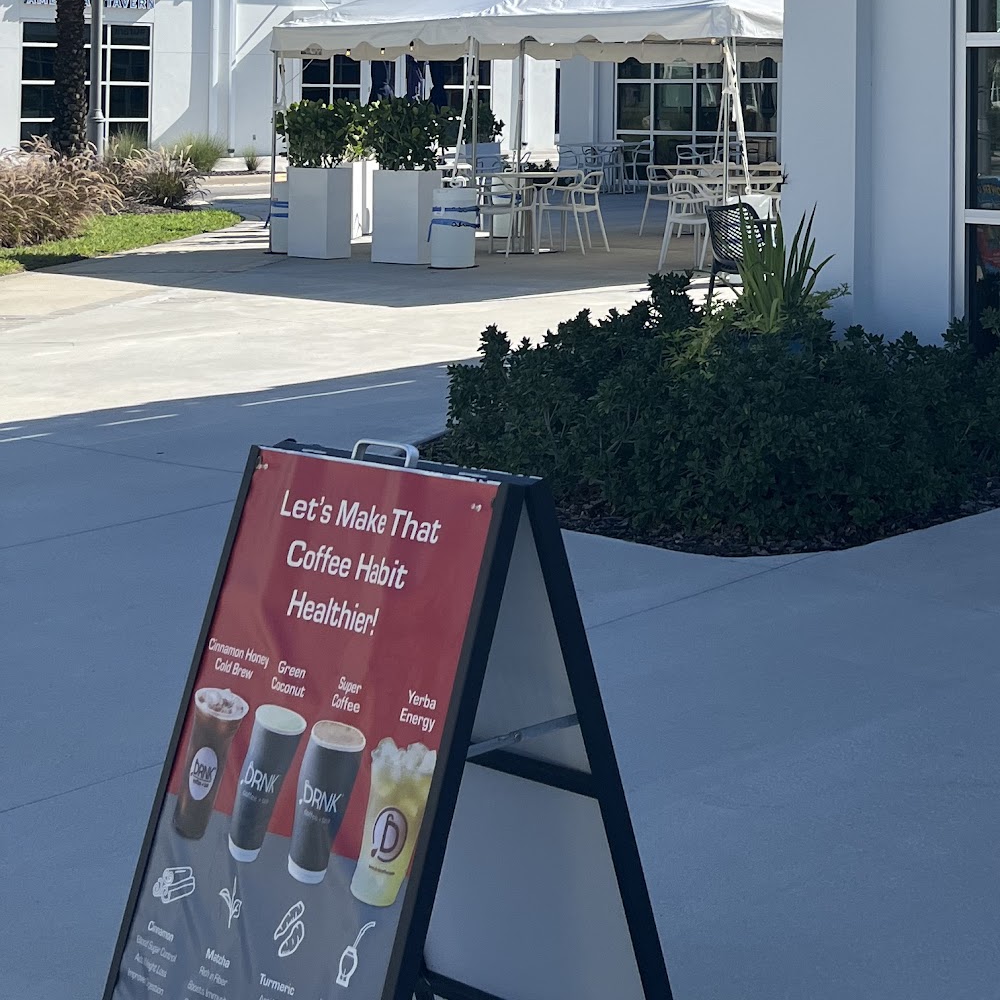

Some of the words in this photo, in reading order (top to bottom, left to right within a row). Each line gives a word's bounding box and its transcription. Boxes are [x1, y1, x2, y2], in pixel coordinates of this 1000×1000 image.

[280, 489, 333, 525] Let's
[335, 500, 387, 535] Make
[390, 508, 442, 544] That
[286, 540, 352, 578] Coffee
[355, 552, 408, 590] Habit
[287, 589, 380, 637] Healthier!
[208, 637, 245, 660] Cinnamon
[246, 648, 270, 669] Honey
[214, 657, 231, 674] Cold
[232, 664, 254, 680] Brew
[277, 660, 306, 680] Green
[271, 677, 306, 698] Coconut
[338, 676, 362, 696] Super
[331, 693, 360, 714] Coffee
[408, 690, 437, 711] Yerba
[399, 708, 436, 732] Energy
[190, 758, 217, 781] DRNK
[240, 761, 280, 793] DRNK
[299, 779, 342, 813] DRNK
[147, 920, 174, 942] Cinnamon
[147, 940, 161, 955] Sugar
[160, 947, 178, 962] Control
[205, 947, 231, 968] Matcha
[156, 966, 167, 977] Loss
[214, 973, 228, 986] Fiber
[259, 972, 295, 996] Turmeric
